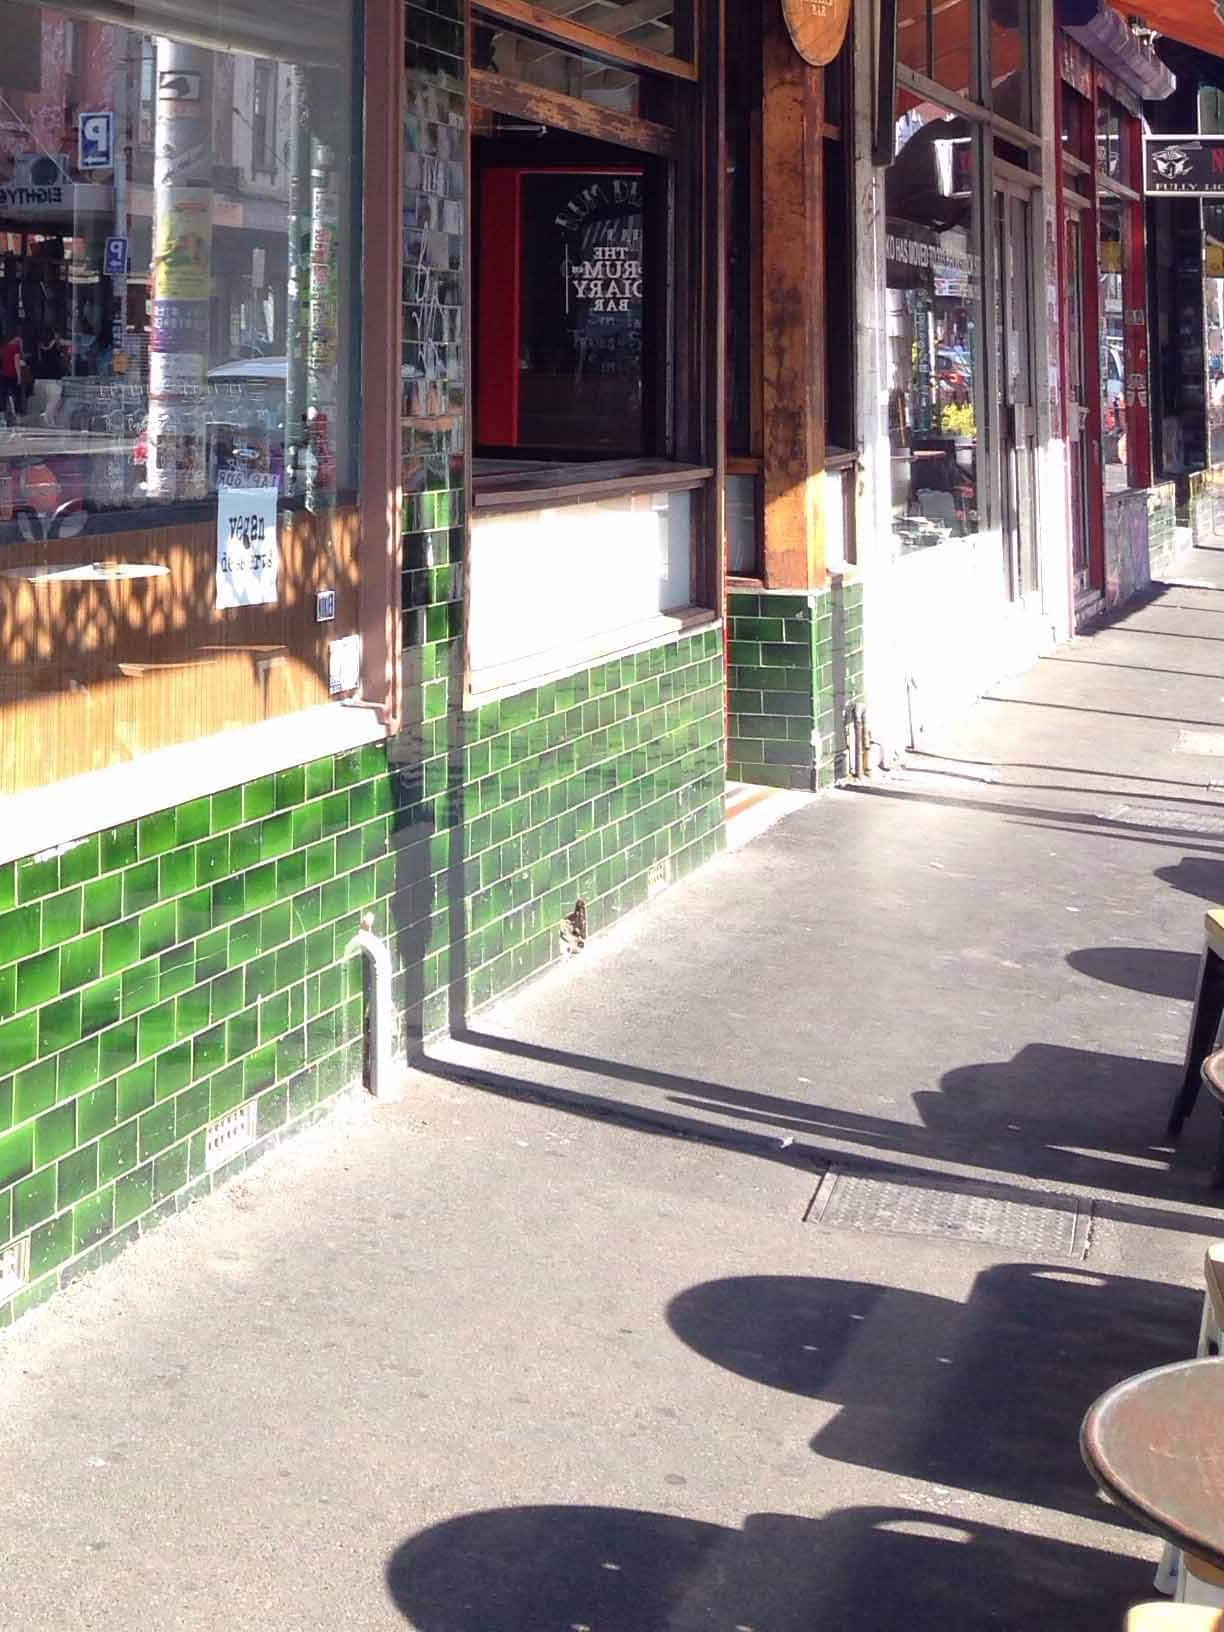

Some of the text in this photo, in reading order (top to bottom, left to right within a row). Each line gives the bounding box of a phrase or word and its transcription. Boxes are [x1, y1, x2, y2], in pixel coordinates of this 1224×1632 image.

[811, 5, 826, 17] BAR
[1156, 183, 1197, 191] FULLY
[229, 514, 266, 550] vegan
